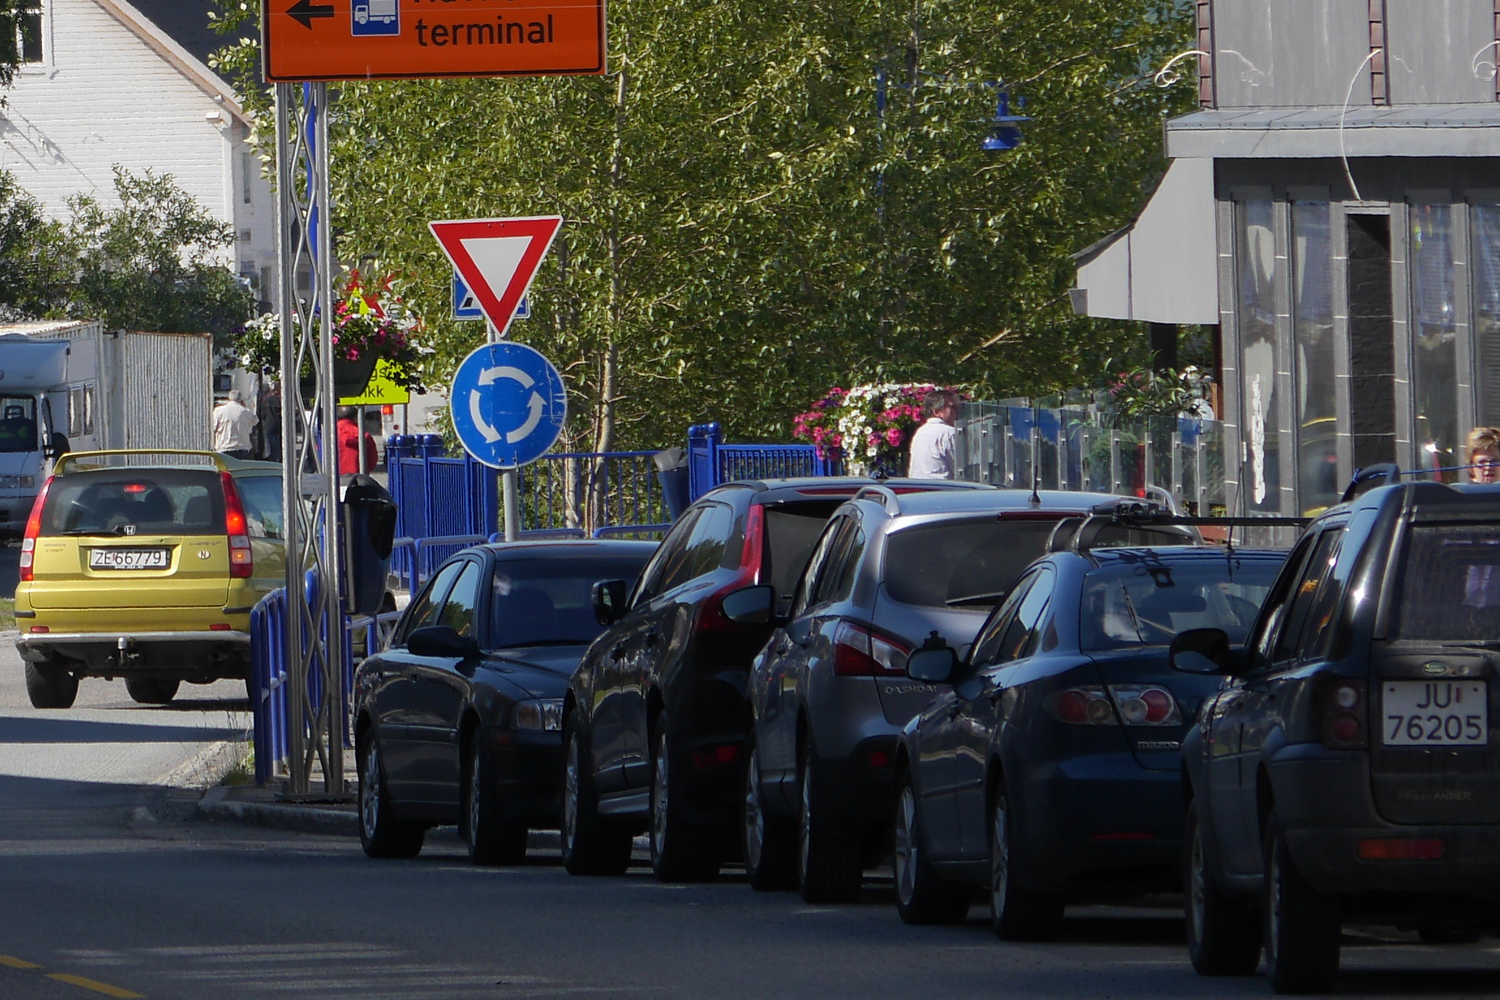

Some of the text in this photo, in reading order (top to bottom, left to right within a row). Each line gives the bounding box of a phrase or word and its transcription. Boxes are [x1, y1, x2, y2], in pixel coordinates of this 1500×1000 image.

[415, 14, 554, 46] terminal
[1416, 683, 1452, 709] JU
[1388, 715, 1482, 740] 76205
